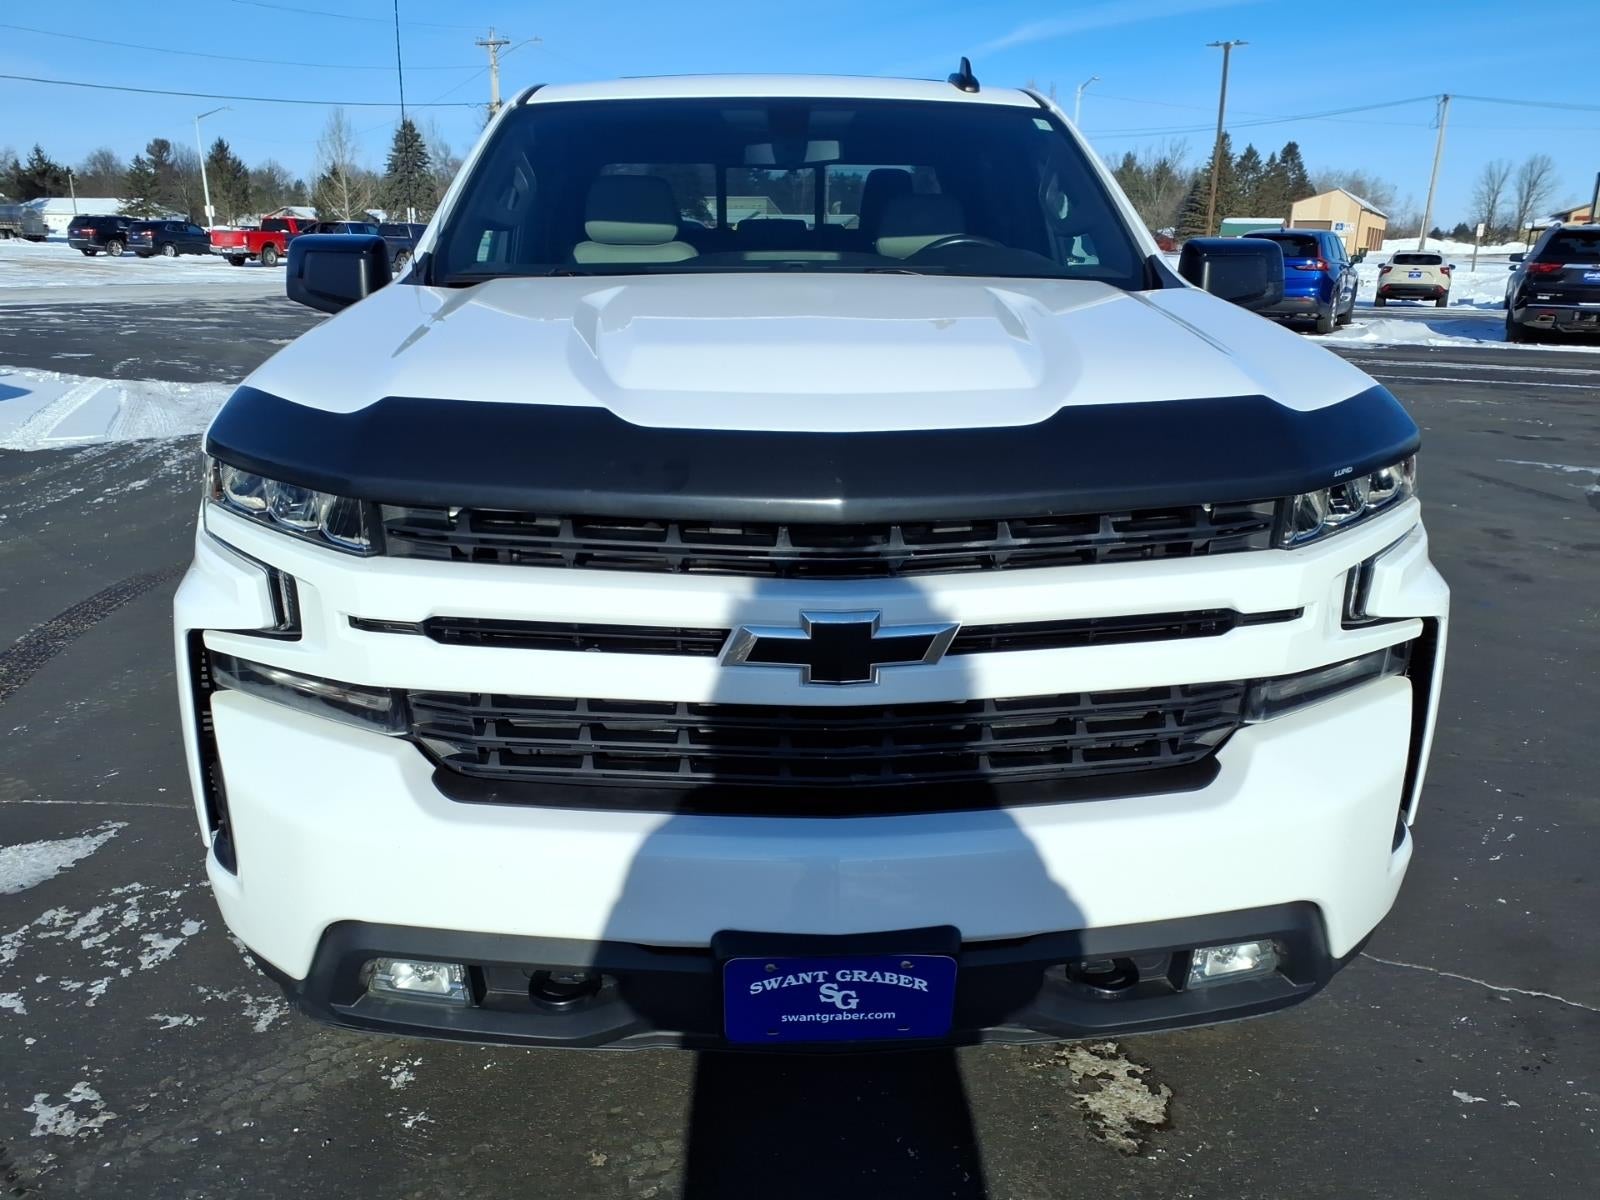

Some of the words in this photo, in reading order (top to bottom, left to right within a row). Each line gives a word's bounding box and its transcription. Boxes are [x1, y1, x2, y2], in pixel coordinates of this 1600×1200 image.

[749, 970, 829, 995] SWANT
[835, 969, 929, 993] GRABER
[819, 983, 860, 1010] SG
[781, 1010, 896, 1024] swantgraber.com
